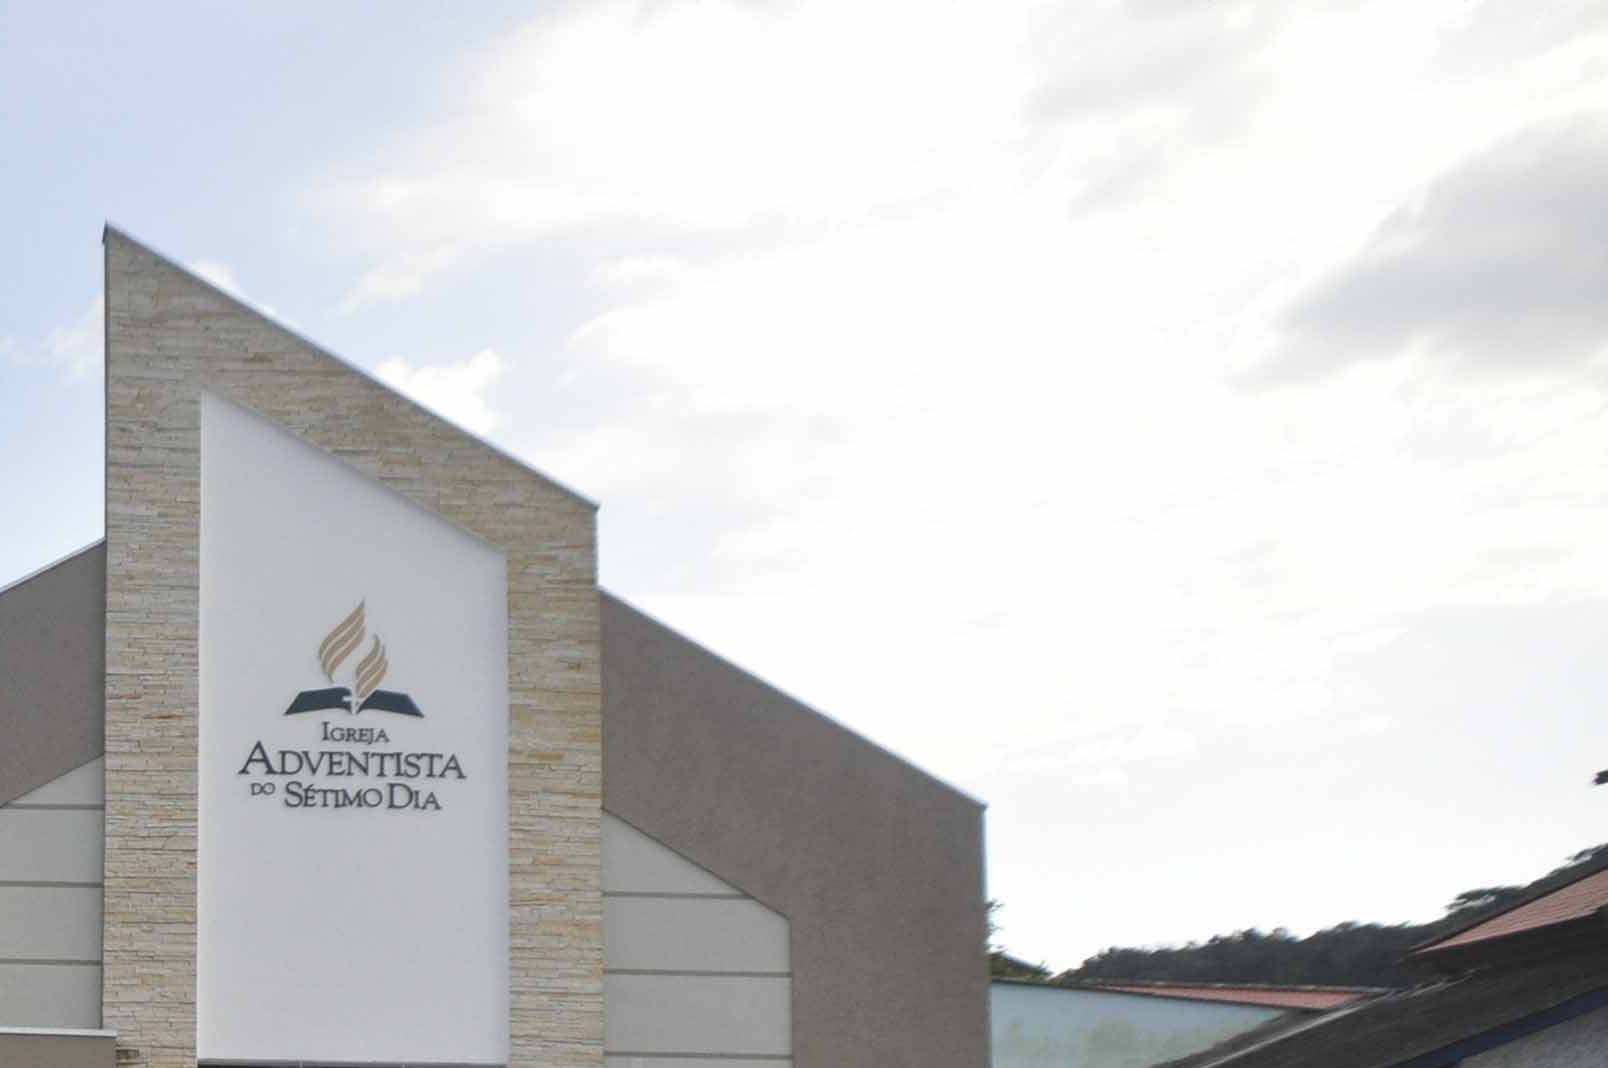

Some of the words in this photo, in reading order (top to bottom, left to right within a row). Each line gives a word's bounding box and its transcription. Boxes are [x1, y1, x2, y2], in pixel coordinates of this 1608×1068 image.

[321, 721, 390, 745] IGREJA
[238, 740, 467, 780] ADVENTISTA
[250, 782, 276, 796] DO
[284, 780, 383, 809] SÉTIMO
[387, 782, 442, 811] DIA
